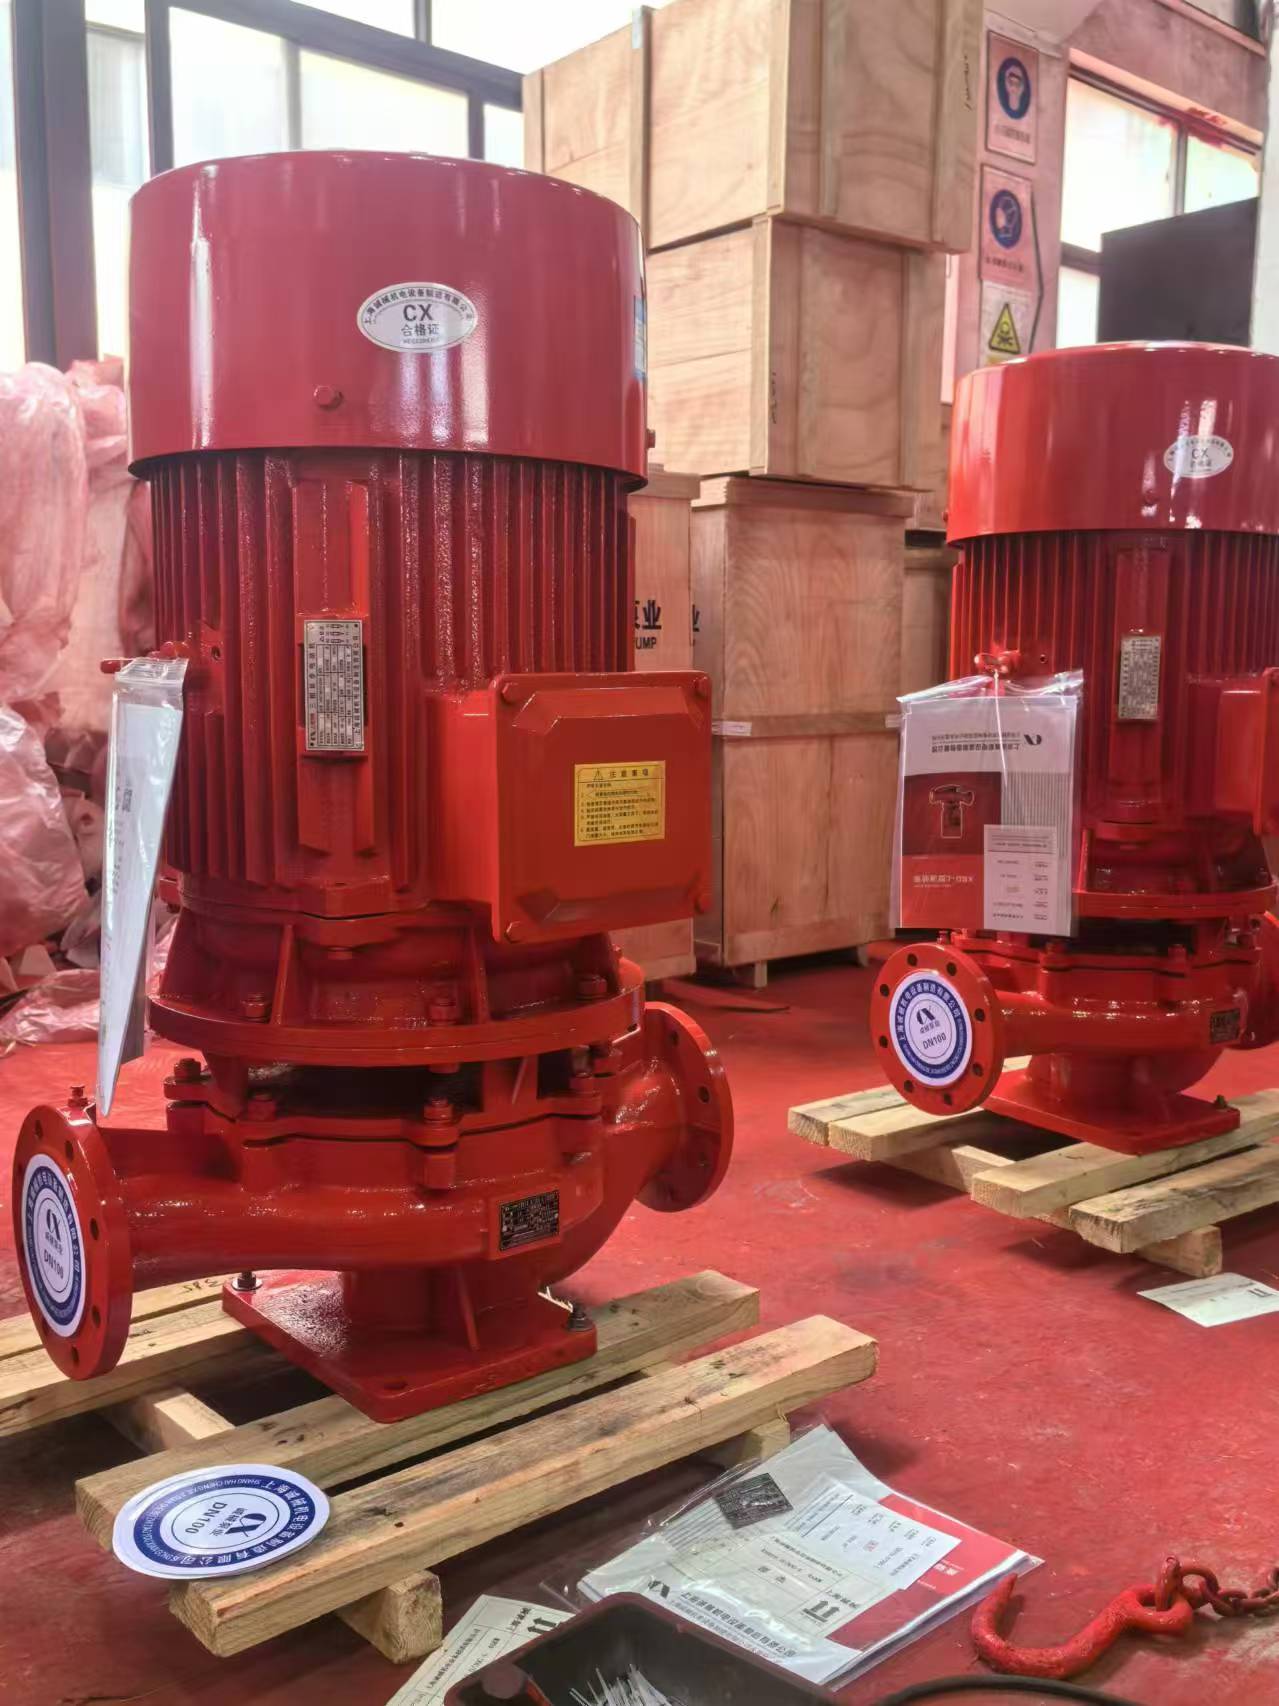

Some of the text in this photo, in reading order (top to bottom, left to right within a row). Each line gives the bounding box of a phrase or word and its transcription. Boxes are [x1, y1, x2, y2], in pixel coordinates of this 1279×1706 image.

[403, 304, 433, 322] CX
[401, 322, 441, 337] 合格证
[635, 637, 657, 650] UMP
[922, 1033, 947, 1050] DN100
[44, 1250, 64, 1279] DN100
[184, 1501, 228, 1535] DN100
